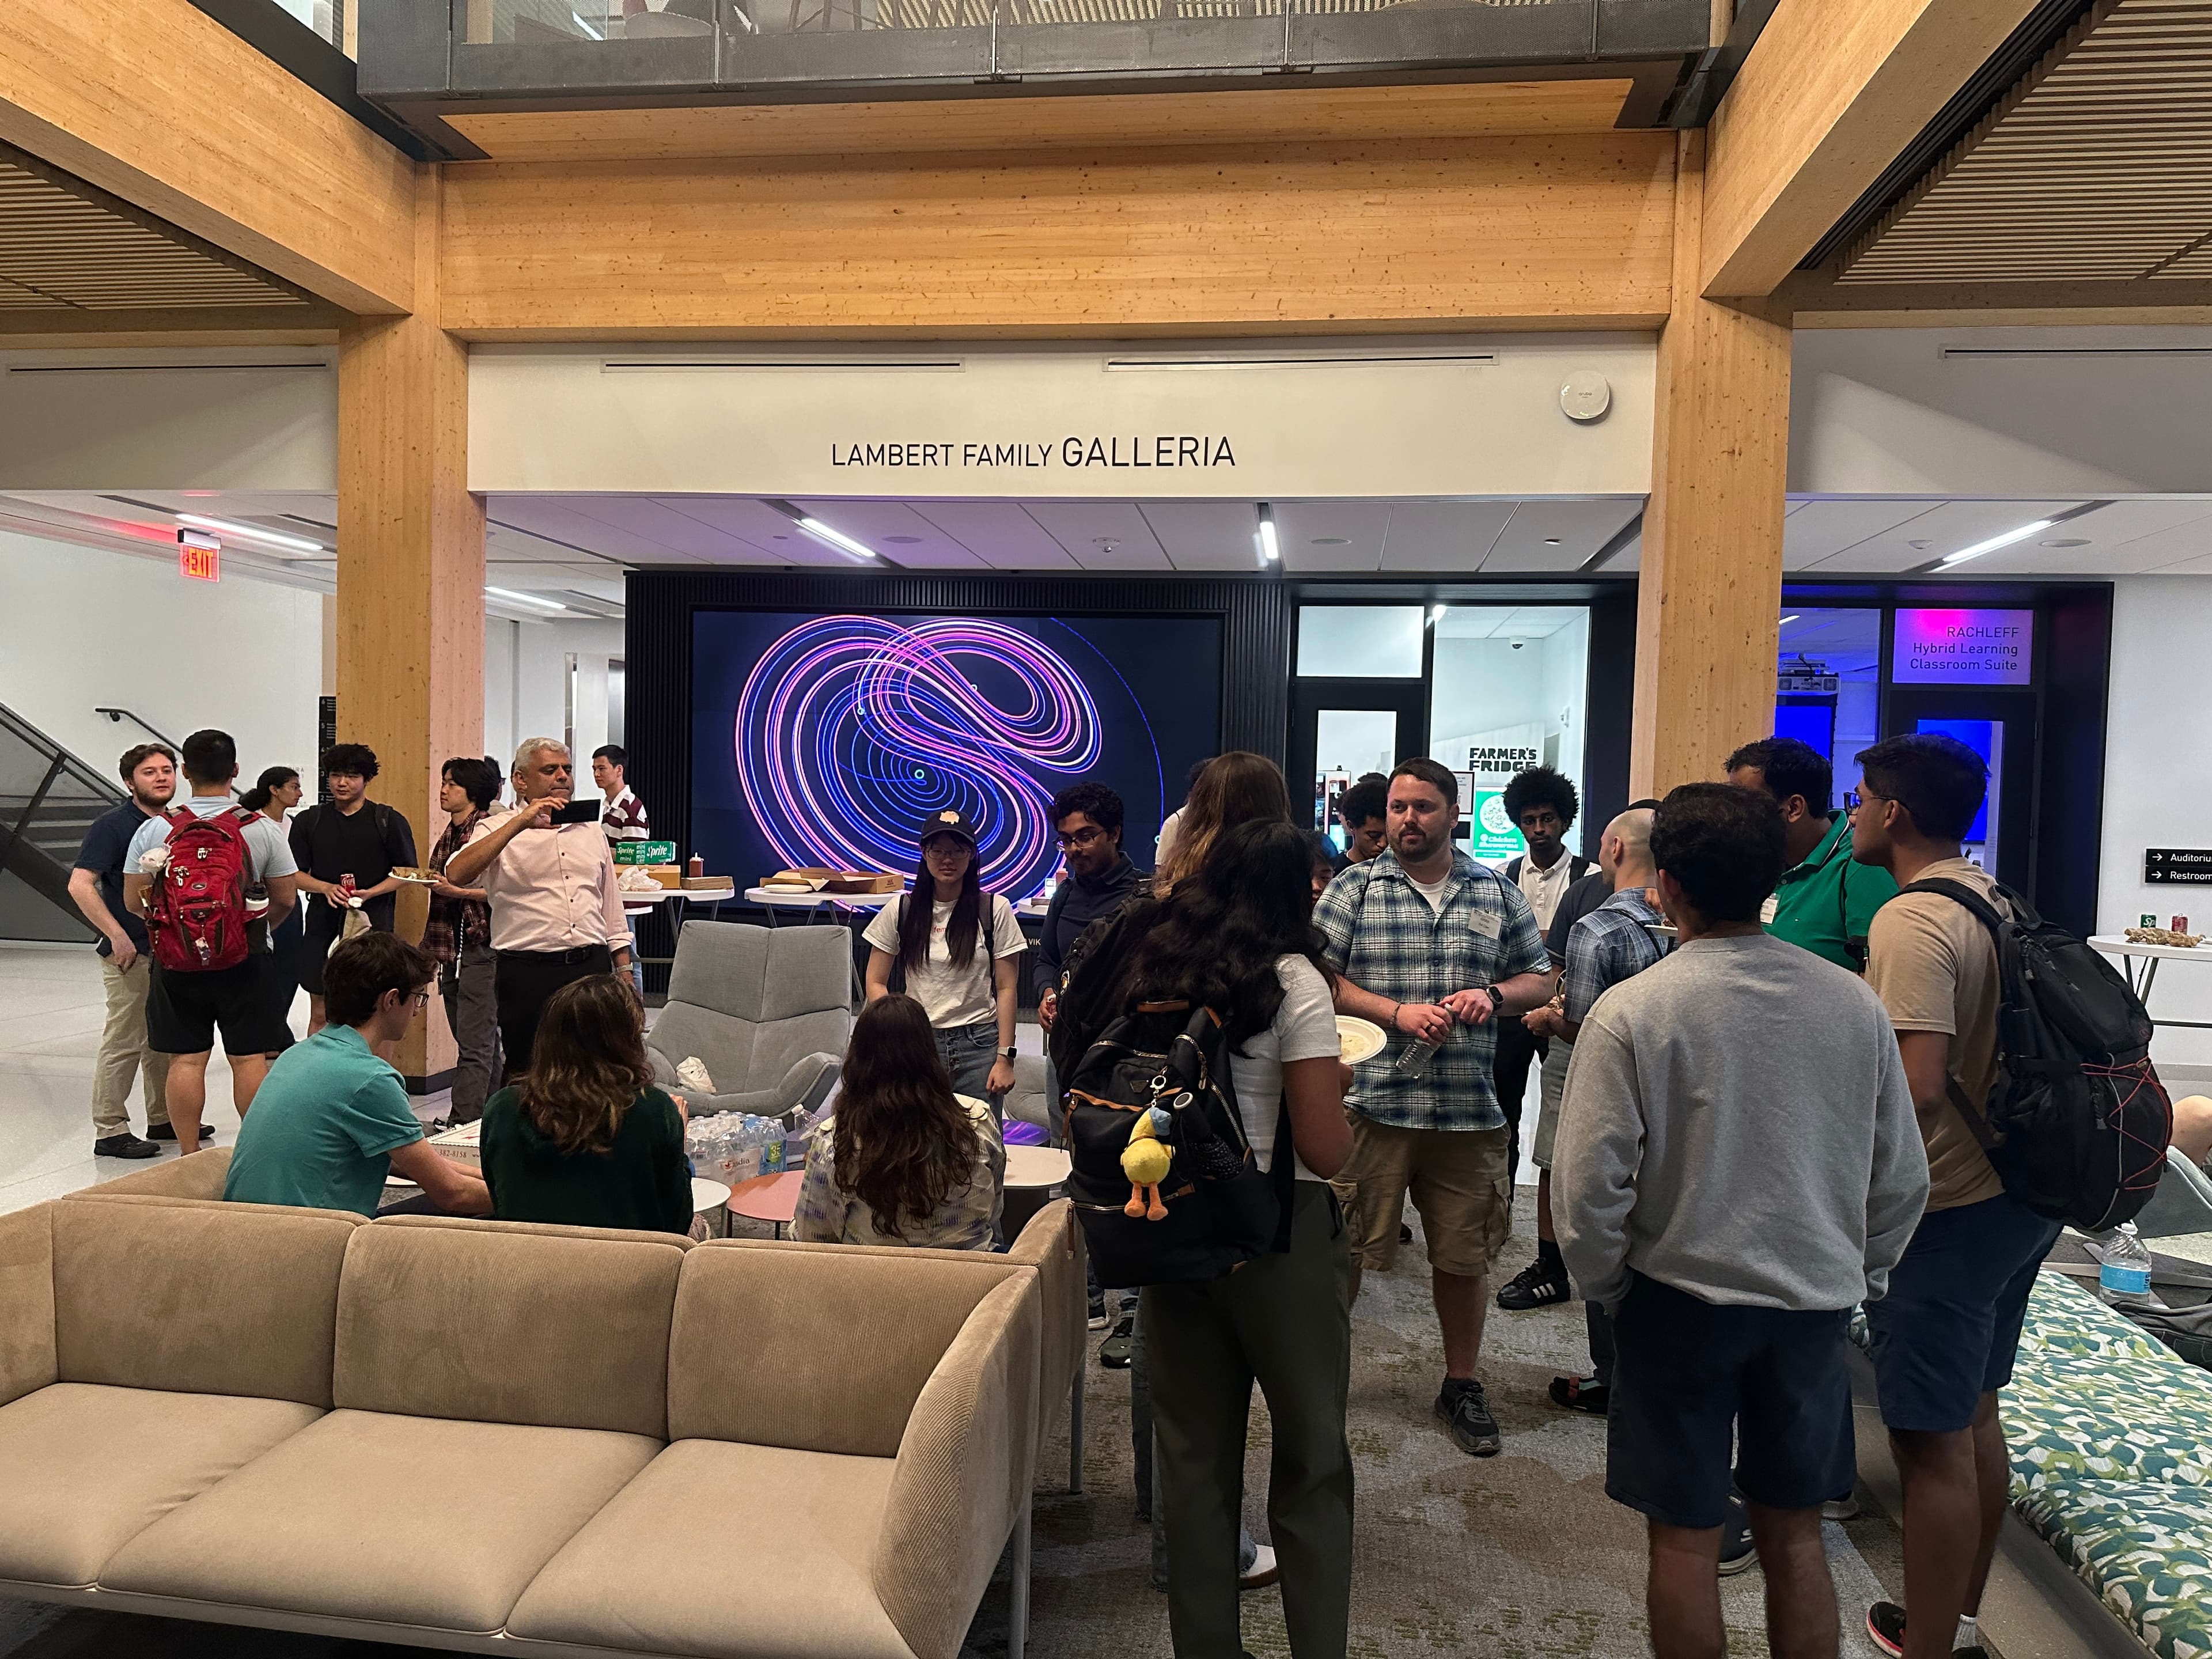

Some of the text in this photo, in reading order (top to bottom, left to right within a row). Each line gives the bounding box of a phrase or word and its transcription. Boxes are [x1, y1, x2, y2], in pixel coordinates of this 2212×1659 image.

[832, 436, 1236, 467] LAMBERT FAMILY GALLERIA
[188, 547, 214, 578] EXIT
[1947, 626, 2019, 638] RACHLEFF
[1913, 642, 2018, 657] Hybrid Learning
[1910, 658, 2017, 671] Classroom Suite
[1469, 748, 1537, 760] FARMER'S
[646, 844, 668, 858] Sprite
[439, 1149, 467, 1158] 382-8158
